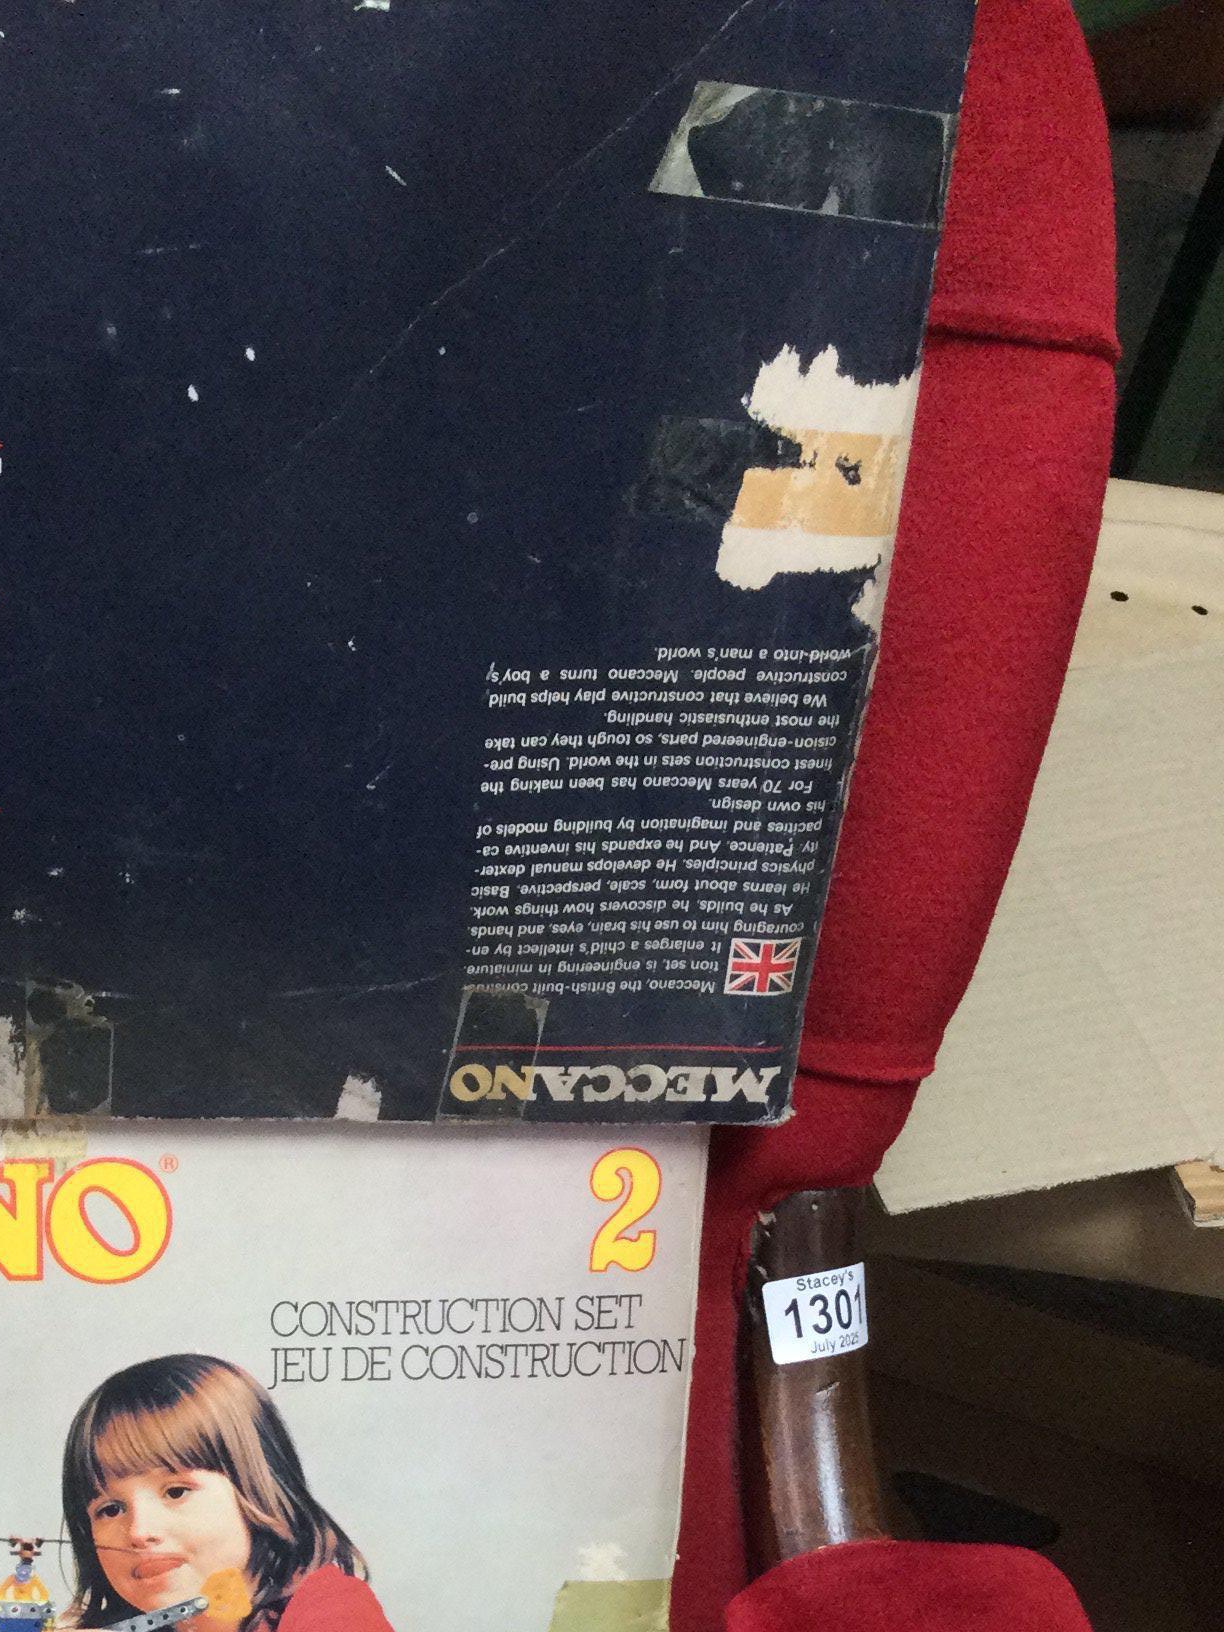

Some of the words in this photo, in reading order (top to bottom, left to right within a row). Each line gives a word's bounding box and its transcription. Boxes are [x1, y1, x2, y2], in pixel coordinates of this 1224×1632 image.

[654, 647, 701, 660] world.
[708, 648, 753, 661] man's
[759, 649, 768, 659] a
[489, 669, 530, 683] boy's
[540, 670, 550, 680] a
[560, 669, 597, 680] turns
[608, 668, 678, 682] Meccano
[691, 669, 746, 682] people.
[756, 671, 847, 684] constructive
[487, 692, 526, 705] build
[531, 691, 570, 704] helps
[574, 690, 606, 704] play
[612, 690, 704, 704] constructive
[710, 692, 740, 704] that
[744, 692, 798, 706] believe
[803, 694, 827, 707] We
[604, 711, 673, 725] handling.
[679, 713, 769, 726] enthusiastic
[775, 715, 813, 726] most
[818, 715, 840, 728] the
[485, 737, 515, 750] take
[521, 736, 547, 747] can
[551, 734, 582, 748] they
[588, 734, 630, 747] tough
[635, 734, 653, 744] so
[658, 734, 698, 745] parts,
[702, 735, 836, 748] cision-engineered
[484, 758, 513, 770] pre-
[518, 757, 560, 770] Using
[566, 756, 611, 769] world.
[616, 756, 639, 768] the
[644, 756, 657, 768] in
[662, 756, 691, 766] sets
[696, 756, 790, 769] construction
[794, 758, 832, 770] finest
[481, 782, 504, 794] the
[510, 779, 563, 792] making
[569, 777, 604, 790] been
[611, 777, 637, 790] has
[643, 776, 712, 790] Meccano
[718, 777, 757, 789] years
[760, 780, 782, 792] 70
[788, 781, 813, 793] For
[709, 798, 762, 812] design.
[767, 801, 801, 812] own
[806, 800, 825, 813] his
[476, 825, 492, 837] of
[496, 822, 548, 836] models
[554, 820, 612, 834] building
[616, 819, 635, 832] by
[641, 818, 728, 832] imagination
[733, 820, 762, 832] and
[768, 820, 822, 834] pacities
[476, 846, 499, 856] ca-
[504, 842, 570, 856] inventive
[575, 842, 596, 854] his
[602, 840, 662, 853] expands
[666, 839, 683, 852] he
[689, 840, 721, 853] And
[727, 840, 794, 854] Patience.
[474, 864, 525, 877] dexter-
[531, 862, 583, 874] manual
[587, 859, 651, 872] develops
[656, 859, 676, 872] He
[683, 859, 757, 872] principles.
[762, 860, 814, 874] physics
[471, 886, 510, 898] Basic
[517, 881, 601, 895] perspective.
[607, 880, 646, 893] scale,
[652, 879, 688, 892] form,
[694, 880, 738, 893] about
[743, 882, 786, 894] learns
[792, 882, 810, 894] He
[470, 906, 509, 918] work.
[515, 903, 559, 916] things
[563, 903, 594, 914] how
[600, 900, 666, 912] discovers
[672, 900, 689, 912] he
[697, 900, 744, 913] builds,
[750, 903, 768, 914] he
[774, 904, 793, 915] As
[518, 925, 545, 936] and
[549, 921, 584, 933] eyes,
[588, 921, 626, 934] brain,
[630, 921, 651, 932] his
[654, 920, 679, 930] use
[682, 920, 696, 931] to
[702, 921, 728, 933] him
[734, 921, 804, 933] couraging
[468, 926, 513, 938] hands.
[466, 946, 489, 955] en-
[494, 944, 512, 957] by
[518, 944, 574, 956] intellect
[579, 941, 625, 954] child's
[631, 941, 639, 950] a
[644, 939, 704, 952] enlarges
[711, 942, 721, 952] It
[464, 964, 532, 975] miniature.
[538, 964, 552, 975] in
[558, 960, 640, 974] engineering
[646, 960, 657, 972] is
[663, 959, 686, 970] set,
[691, 960, 718, 972] tion
[532, 982, 616, 994] British-built
[620, 980, 642, 992] the
[646, 979, 715, 992] Meccano,
[449, 1063, 781, 1103] MECCANO
[589, 1146, 663, 1273] 2
[796, 1270, 854, 1291] Stacey's
[270, 1296, 565, 1337] CONSTRUCTION
[575, 1294, 643, 1331] SET
[784, 1283, 863, 1338] 1301
[811, 1338, 836, 1354] July
[267, 1346, 332, 1390] JEU
[341, 1346, 392, 1382] DE
[401, 1338, 687, 1380] CONSTRUCTION
